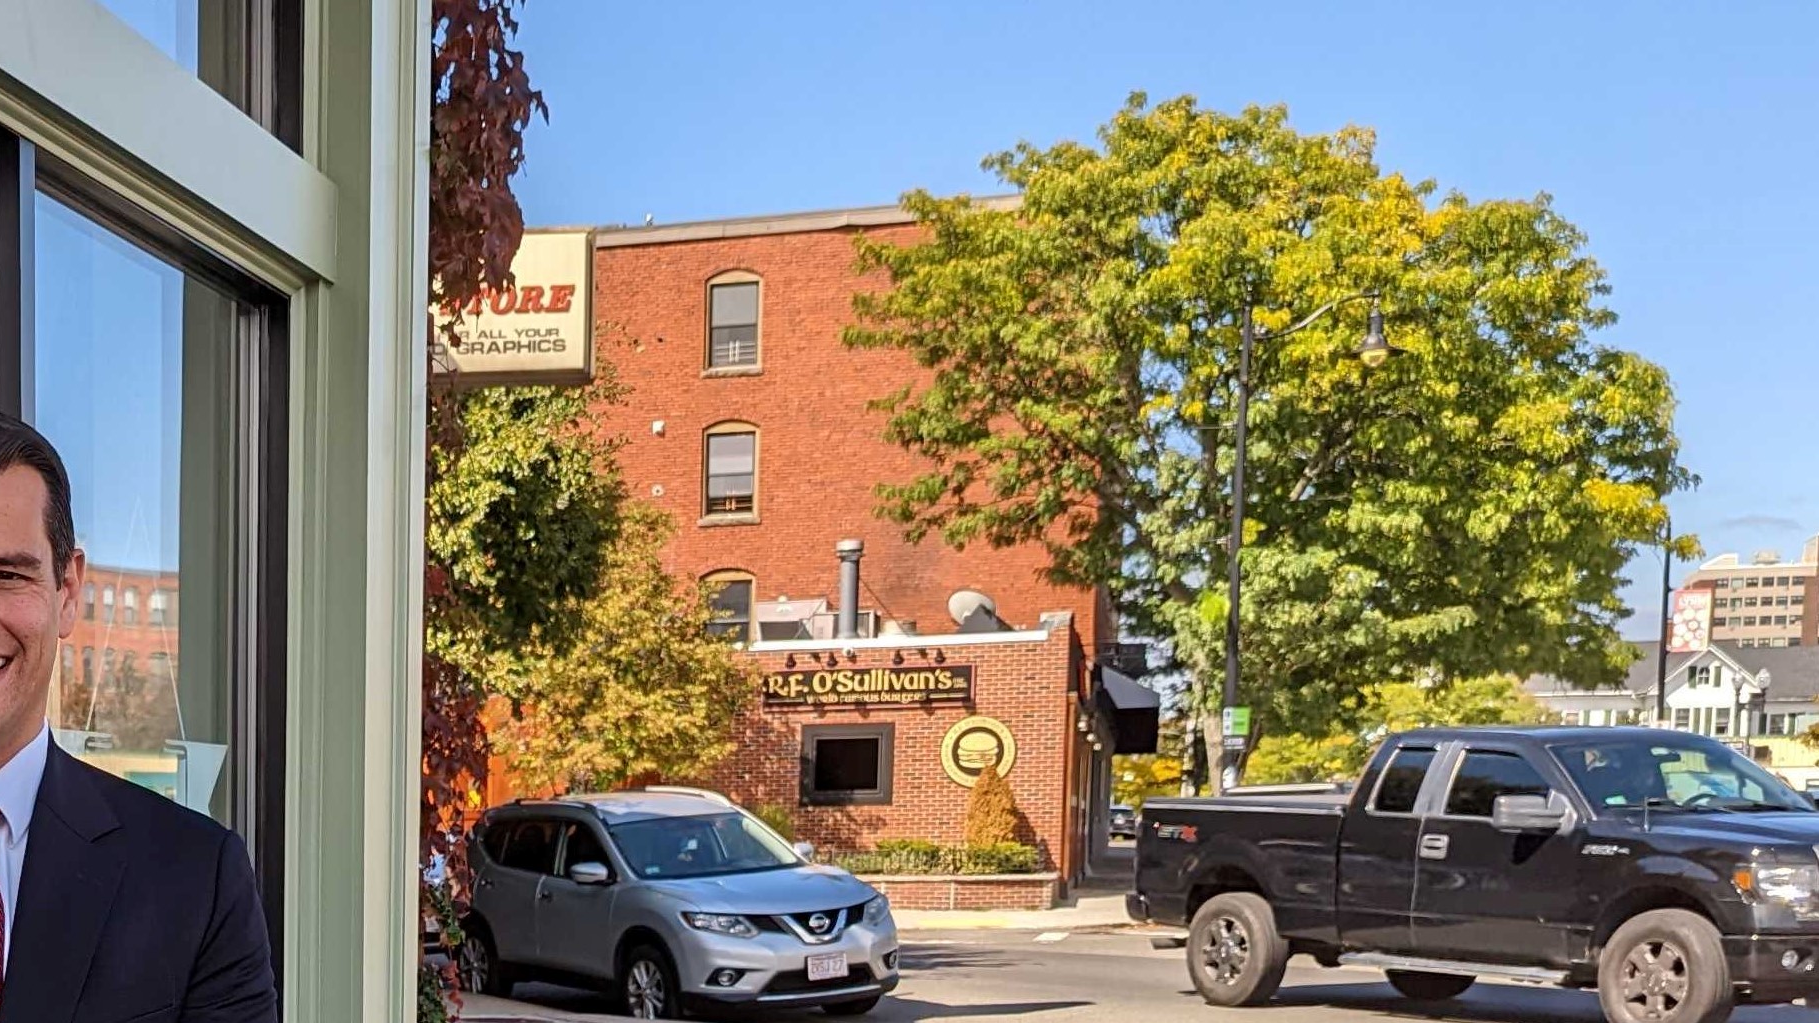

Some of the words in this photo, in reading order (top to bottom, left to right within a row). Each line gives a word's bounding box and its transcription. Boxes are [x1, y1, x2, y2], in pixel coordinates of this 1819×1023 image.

[477, 329, 507, 339] ALL
[515, 328, 560, 338] YOUR
[456, 338, 566, 355] GRAPHICS
